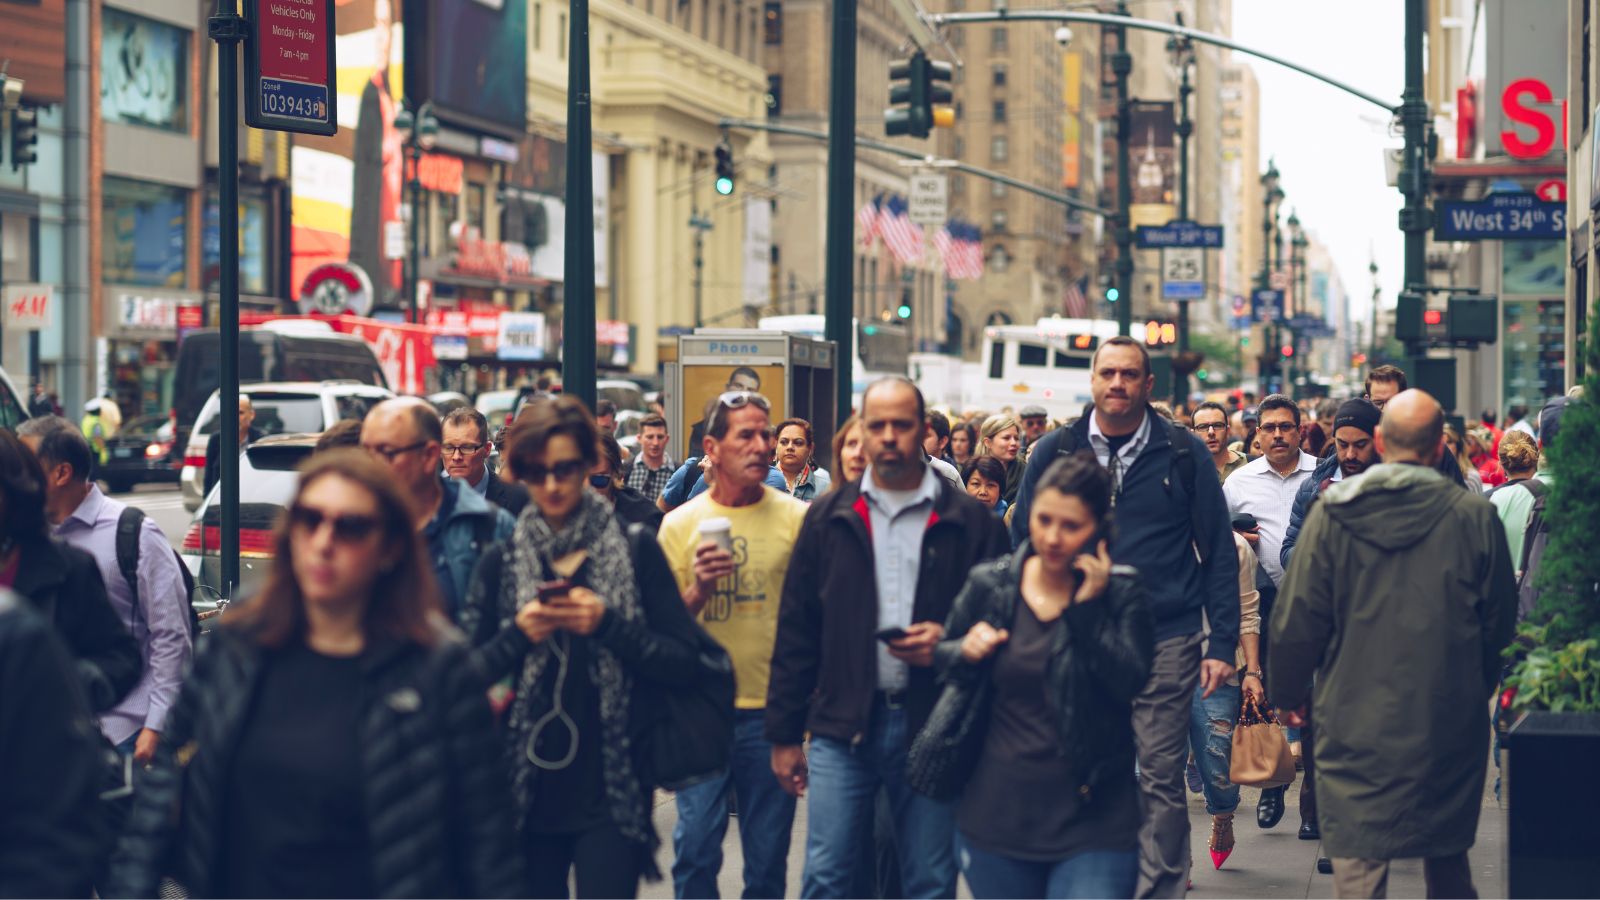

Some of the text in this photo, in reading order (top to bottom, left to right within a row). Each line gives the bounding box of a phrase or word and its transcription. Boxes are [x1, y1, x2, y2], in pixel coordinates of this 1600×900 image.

[271, 4, 316, 23] Vehicles Only
[272, 25, 295, 40] Monday
[298, 29, 315, 43] Friday
[263, 82, 281, 91] Zone#
[264, 93, 312, 116] 103943
[1501, 78, 1567, 160] S
[1452, 209, 1504, 232] West
[1509, 207, 1547, 232] 34th
[1169, 259, 1199, 280] 25
[709, 342, 760, 354] Phone
